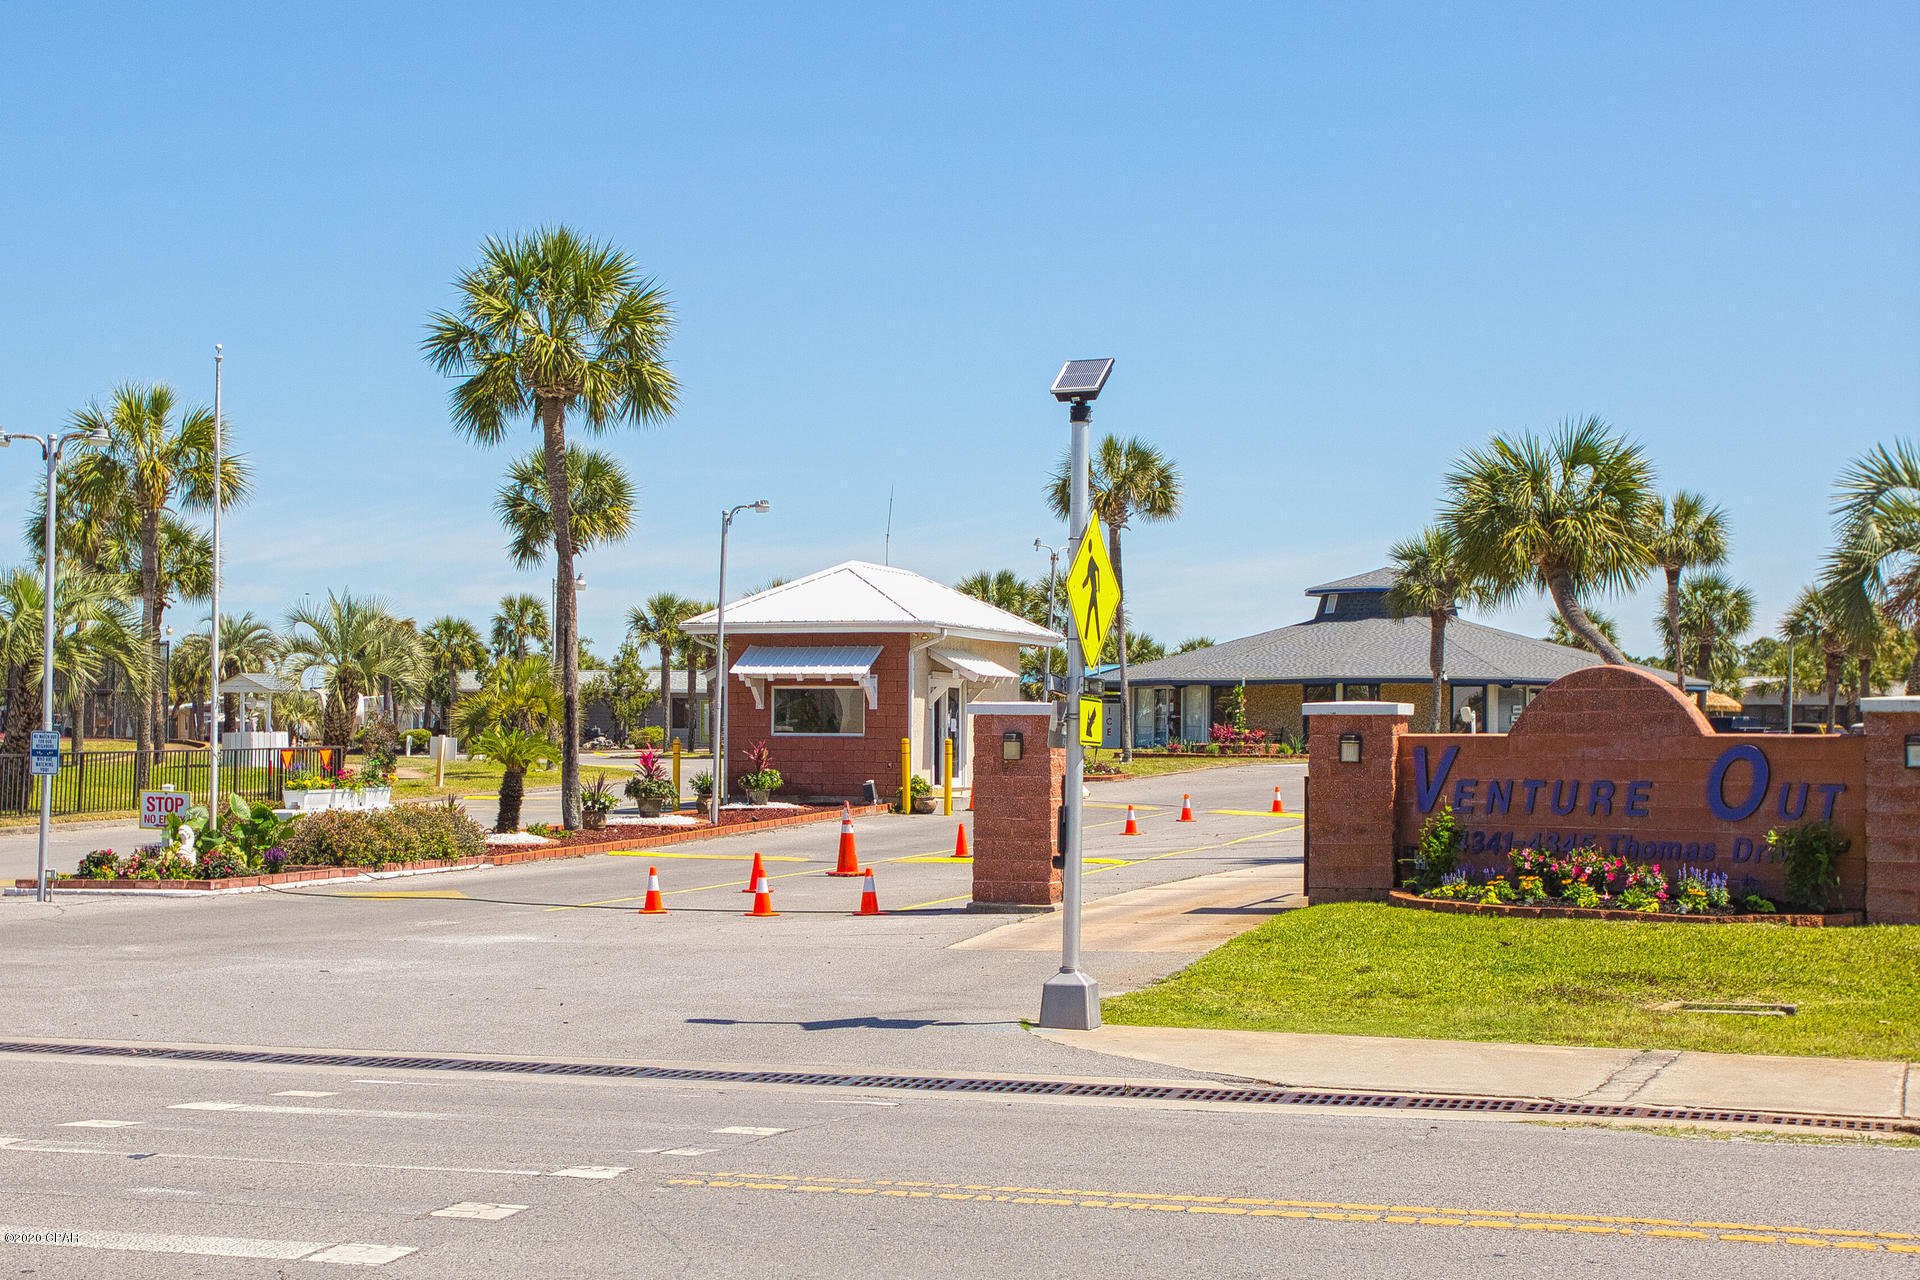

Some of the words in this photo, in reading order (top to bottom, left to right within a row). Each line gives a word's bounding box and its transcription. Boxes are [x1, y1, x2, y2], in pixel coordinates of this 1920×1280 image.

[1413, 745, 1653, 817] VENTURE
[1706, 744, 1847, 821] OUT
[146, 796, 184, 813] STOP
[144, 814, 156, 824] NO
[1606, 834, 1717, 861] Thomas
